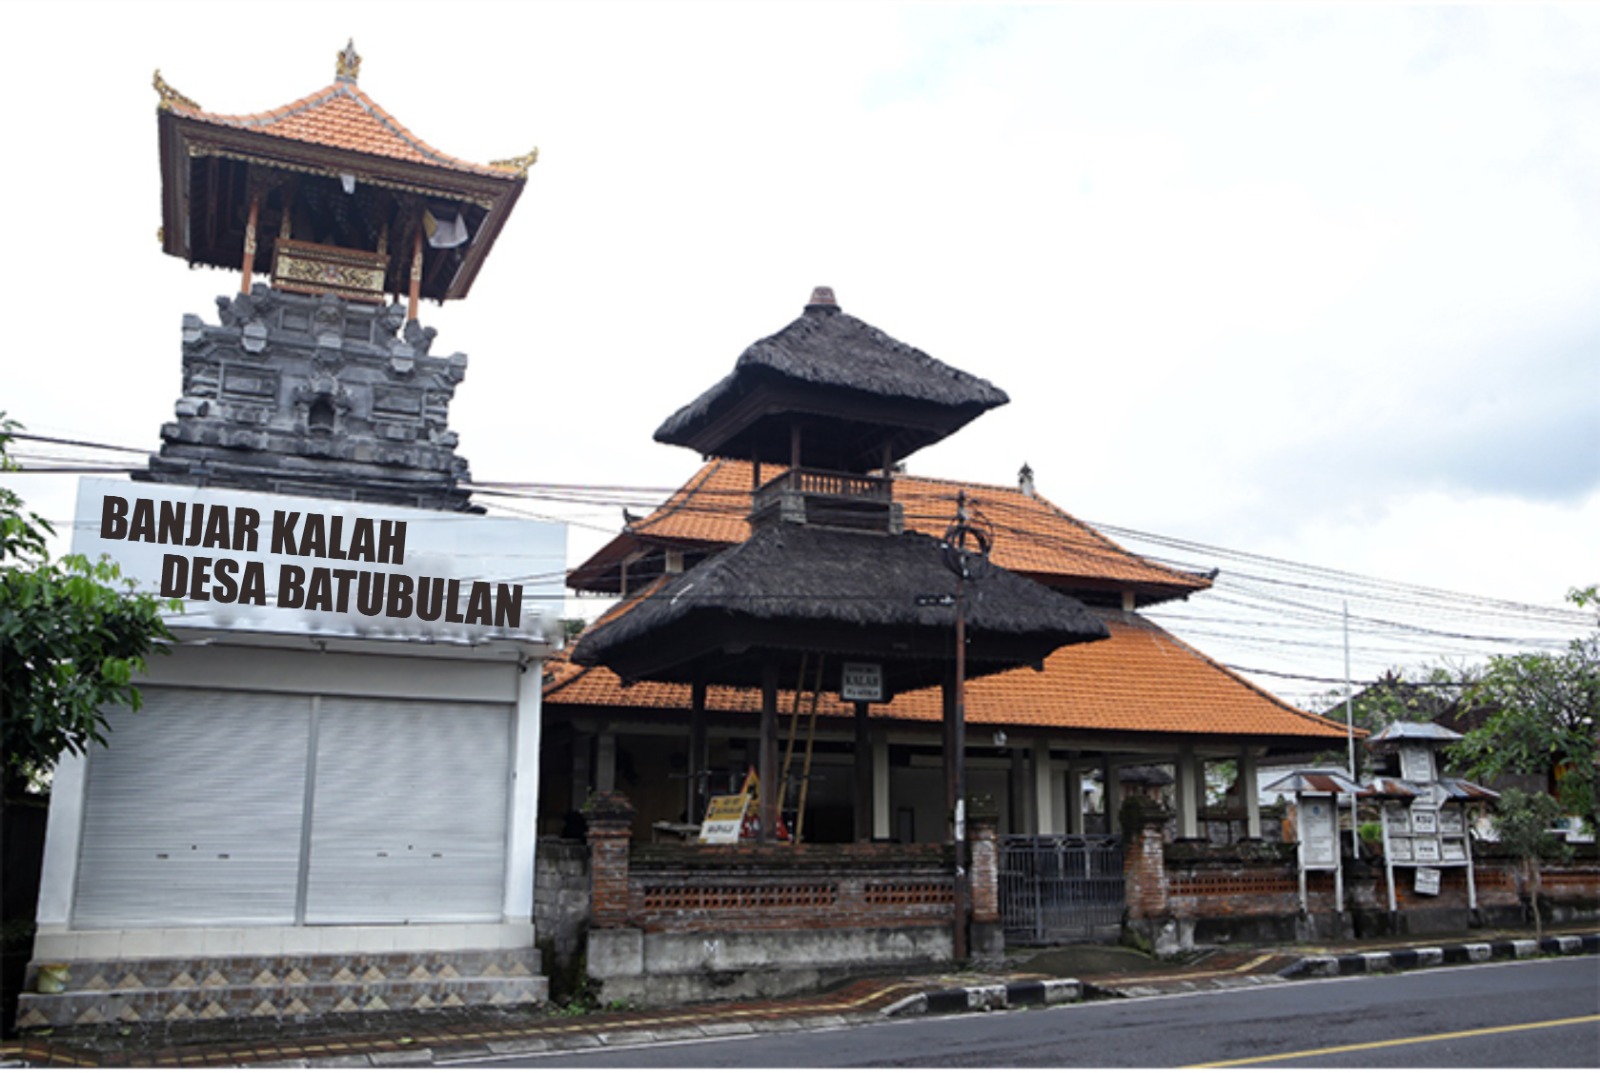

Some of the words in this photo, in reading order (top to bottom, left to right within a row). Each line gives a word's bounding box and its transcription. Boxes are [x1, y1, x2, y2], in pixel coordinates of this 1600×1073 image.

[100, 495, 260, 552] BANJAR
[271, 510, 407, 565] KALAH
[159, 553, 267, 606] DESA
[277, 564, 524, 629] BATUBULAN
